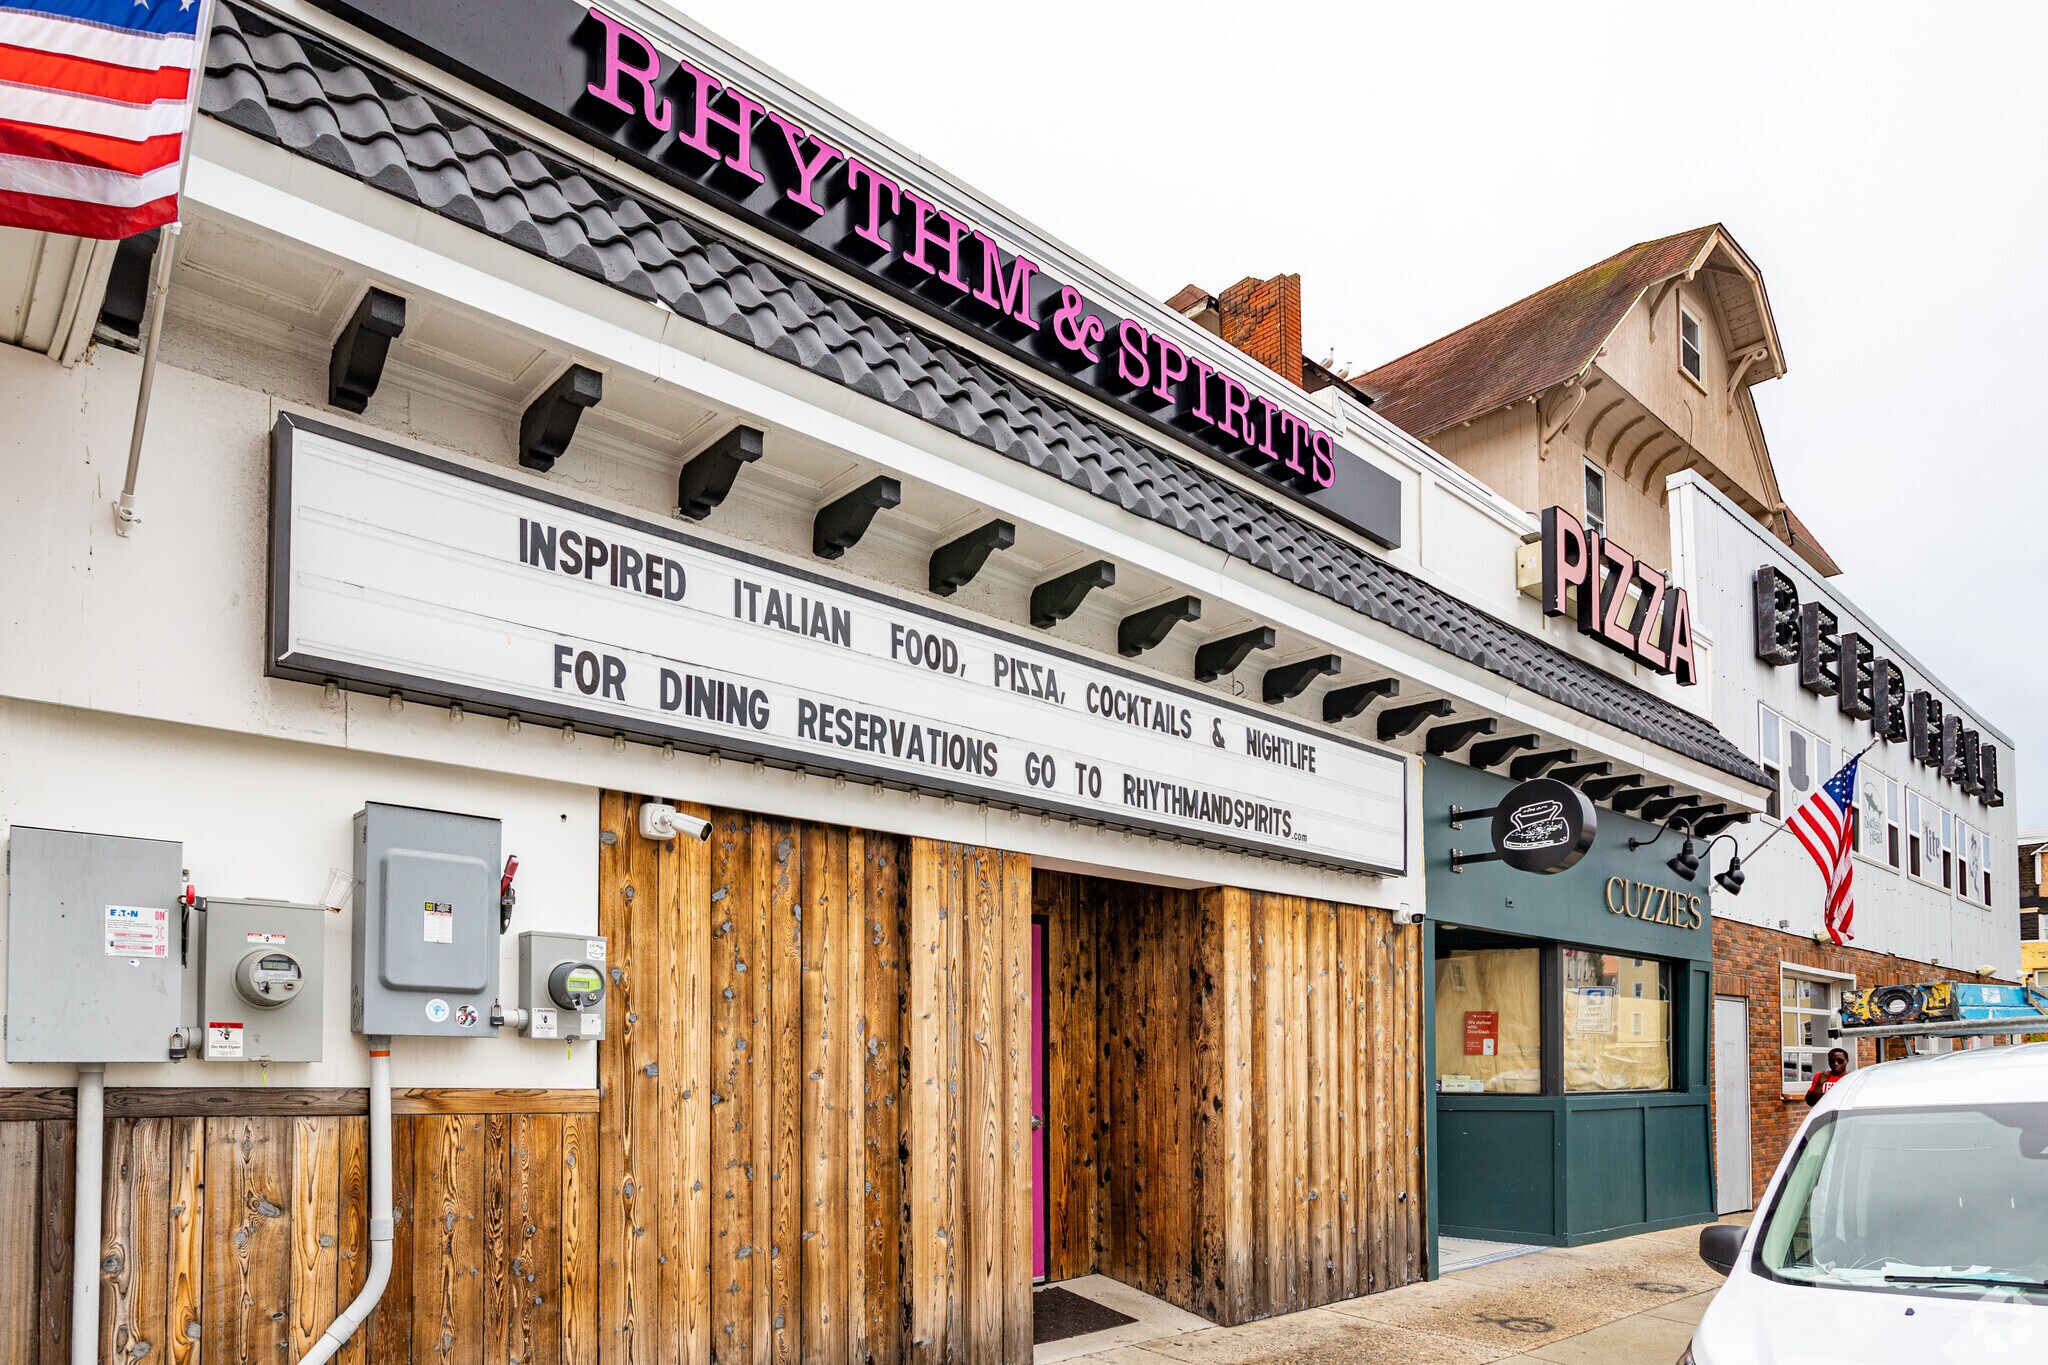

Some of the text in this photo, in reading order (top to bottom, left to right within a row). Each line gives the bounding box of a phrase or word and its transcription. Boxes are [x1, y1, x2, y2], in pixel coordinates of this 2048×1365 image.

[587, 7, 1336, 488] RHYTHM & SPIRITS
[519, 517, 687, 601] INSPIRED
[734, 578, 851, 648] ITALIAN
[891, 622, 966, 677] FOOD,
[1086, 682, 1192, 739] COCKTAILS
[1212, 717, 1225, 748] &
[1246, 727, 1316, 773] NIGHTLIFE
[1542, 506, 1697, 686] PIZZA
[1757, 565, 2004, 807] BEER HALL
[554, 644, 1308, 842] FOR DINING RESERVATIONS GO TO RHYTHMANDSPIRITS.com
[155, 911, 165, 920] ON
[155, 945, 166, 956] OFF
[1606, 876, 1702, 930] CUZZIE'S
